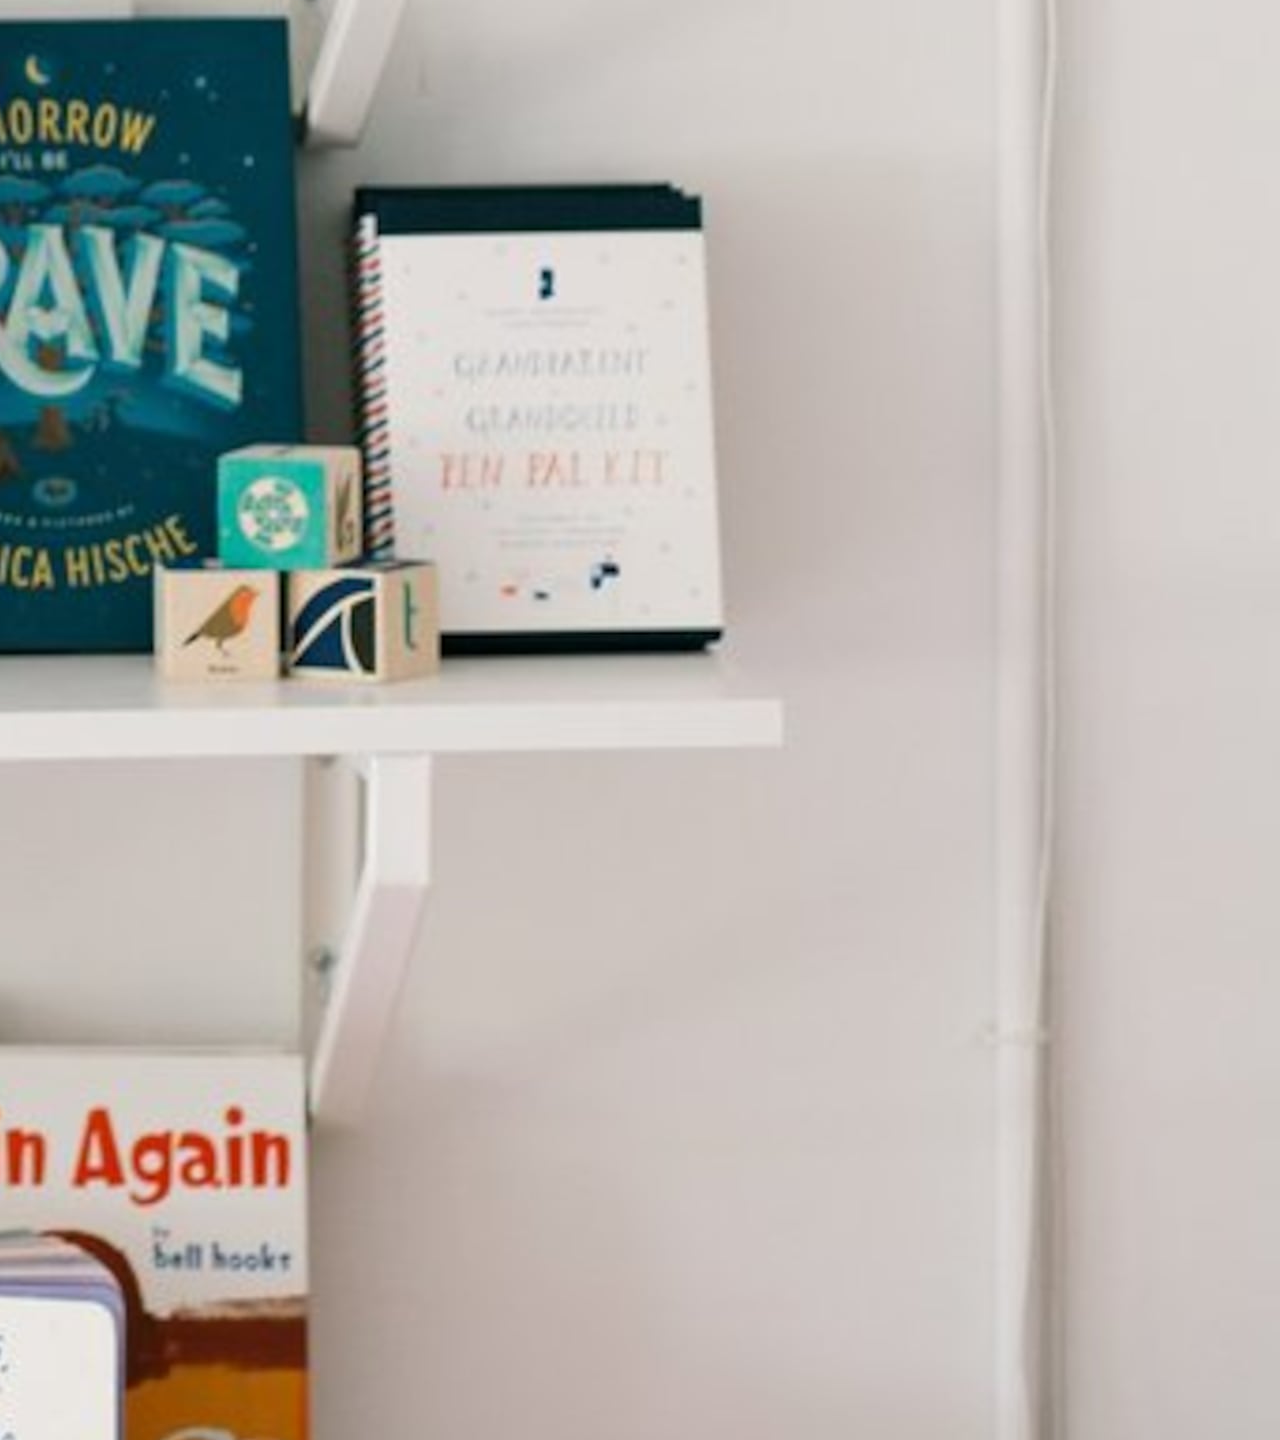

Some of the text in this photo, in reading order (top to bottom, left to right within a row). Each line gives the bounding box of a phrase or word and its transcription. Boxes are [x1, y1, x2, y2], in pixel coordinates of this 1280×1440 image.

[525, 451, 583, 490] PAL
[66, 515, 198, 587] HISCHE
[71, 1105, 291, 1206] Again
[152, 1243, 292, 1272] bell hooks
